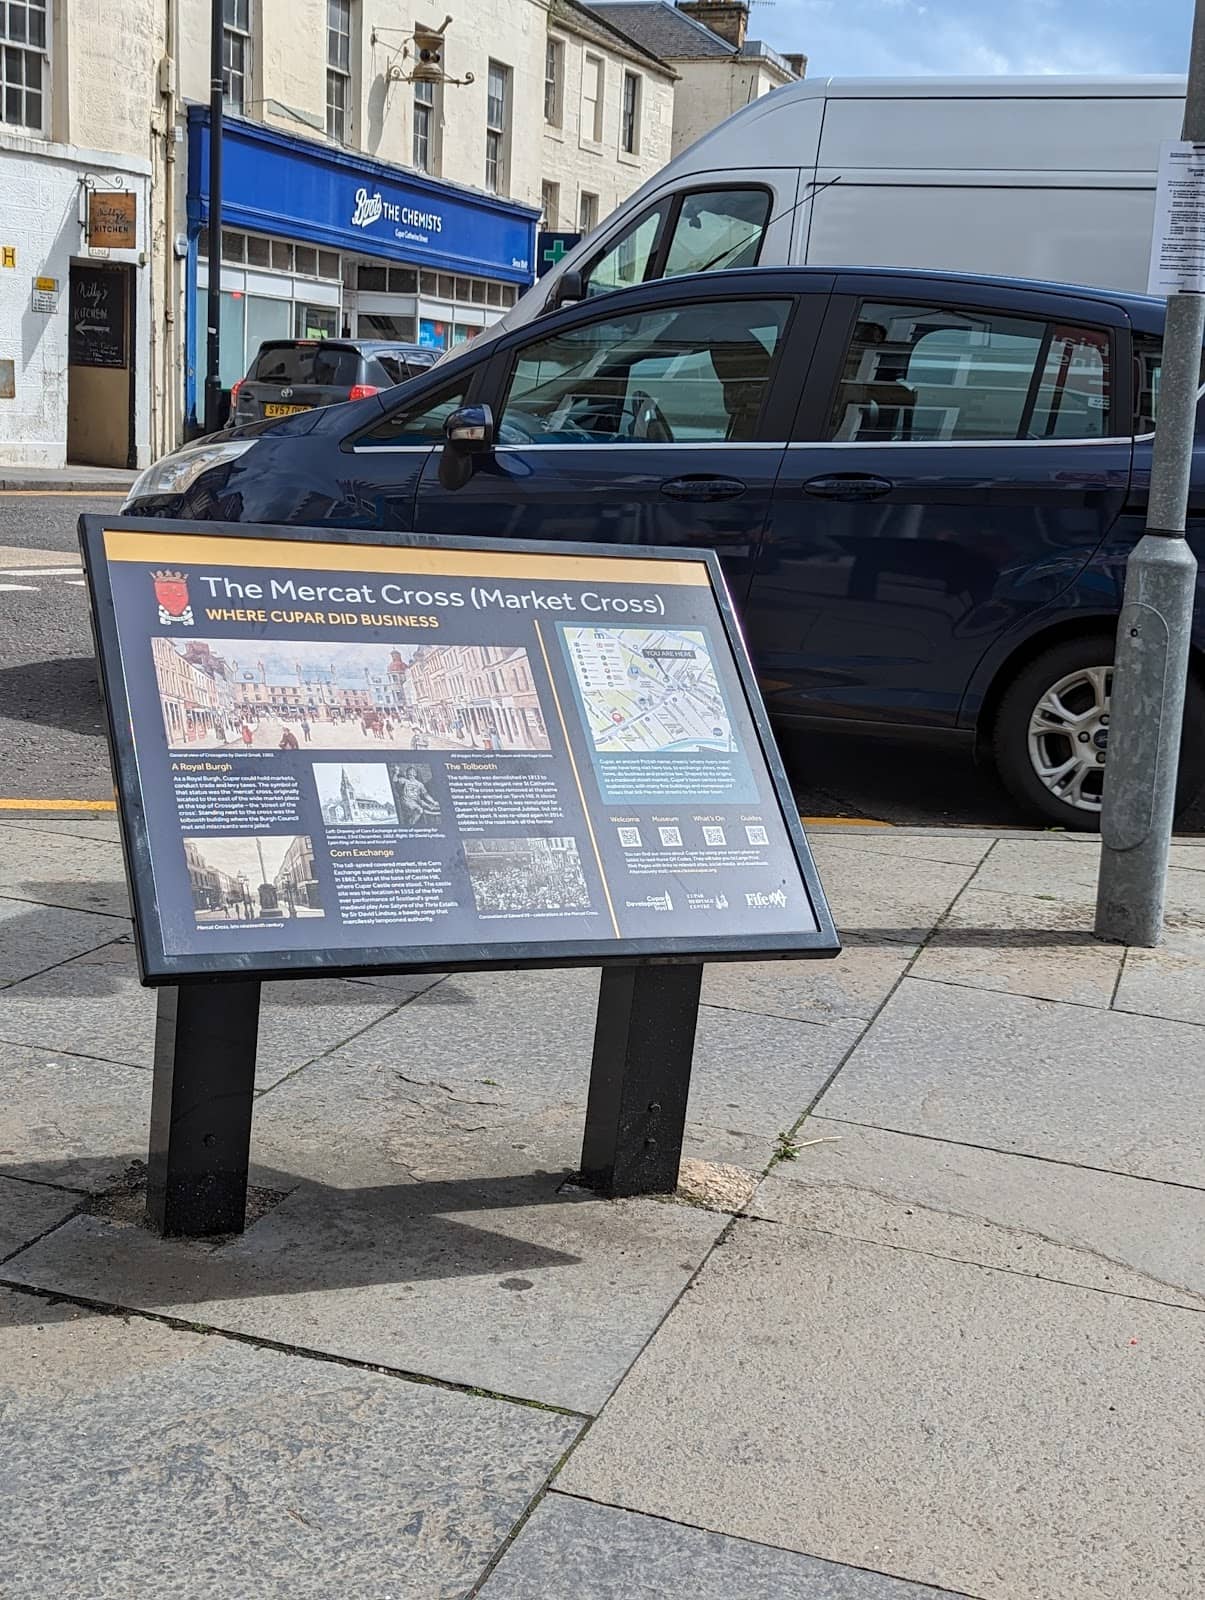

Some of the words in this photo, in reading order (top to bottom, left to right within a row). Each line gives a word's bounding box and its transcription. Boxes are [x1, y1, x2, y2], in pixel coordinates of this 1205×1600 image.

[352, 188, 382, 228] Boots
[383, 202, 400, 222] THE
[402, 208, 442, 232] CHEMISTS
[4, 247, 15, 266] H
[74, 307, 108, 320] KITCHEN
[200, 576, 262, 599] The
[270, 580, 376, 604] Mercat
[381, 584, 464, 607] Cross
[470, 587, 576, 611] (Market
[580, 592, 664, 615] Cross)
[206, 608, 268, 622] WHERE
[271, 610, 325, 624] CUPAR
[328, 613, 357, 625] DID
[362, 615, 439, 628] BUSINESS
[745, 892, 770, 906] Fife
